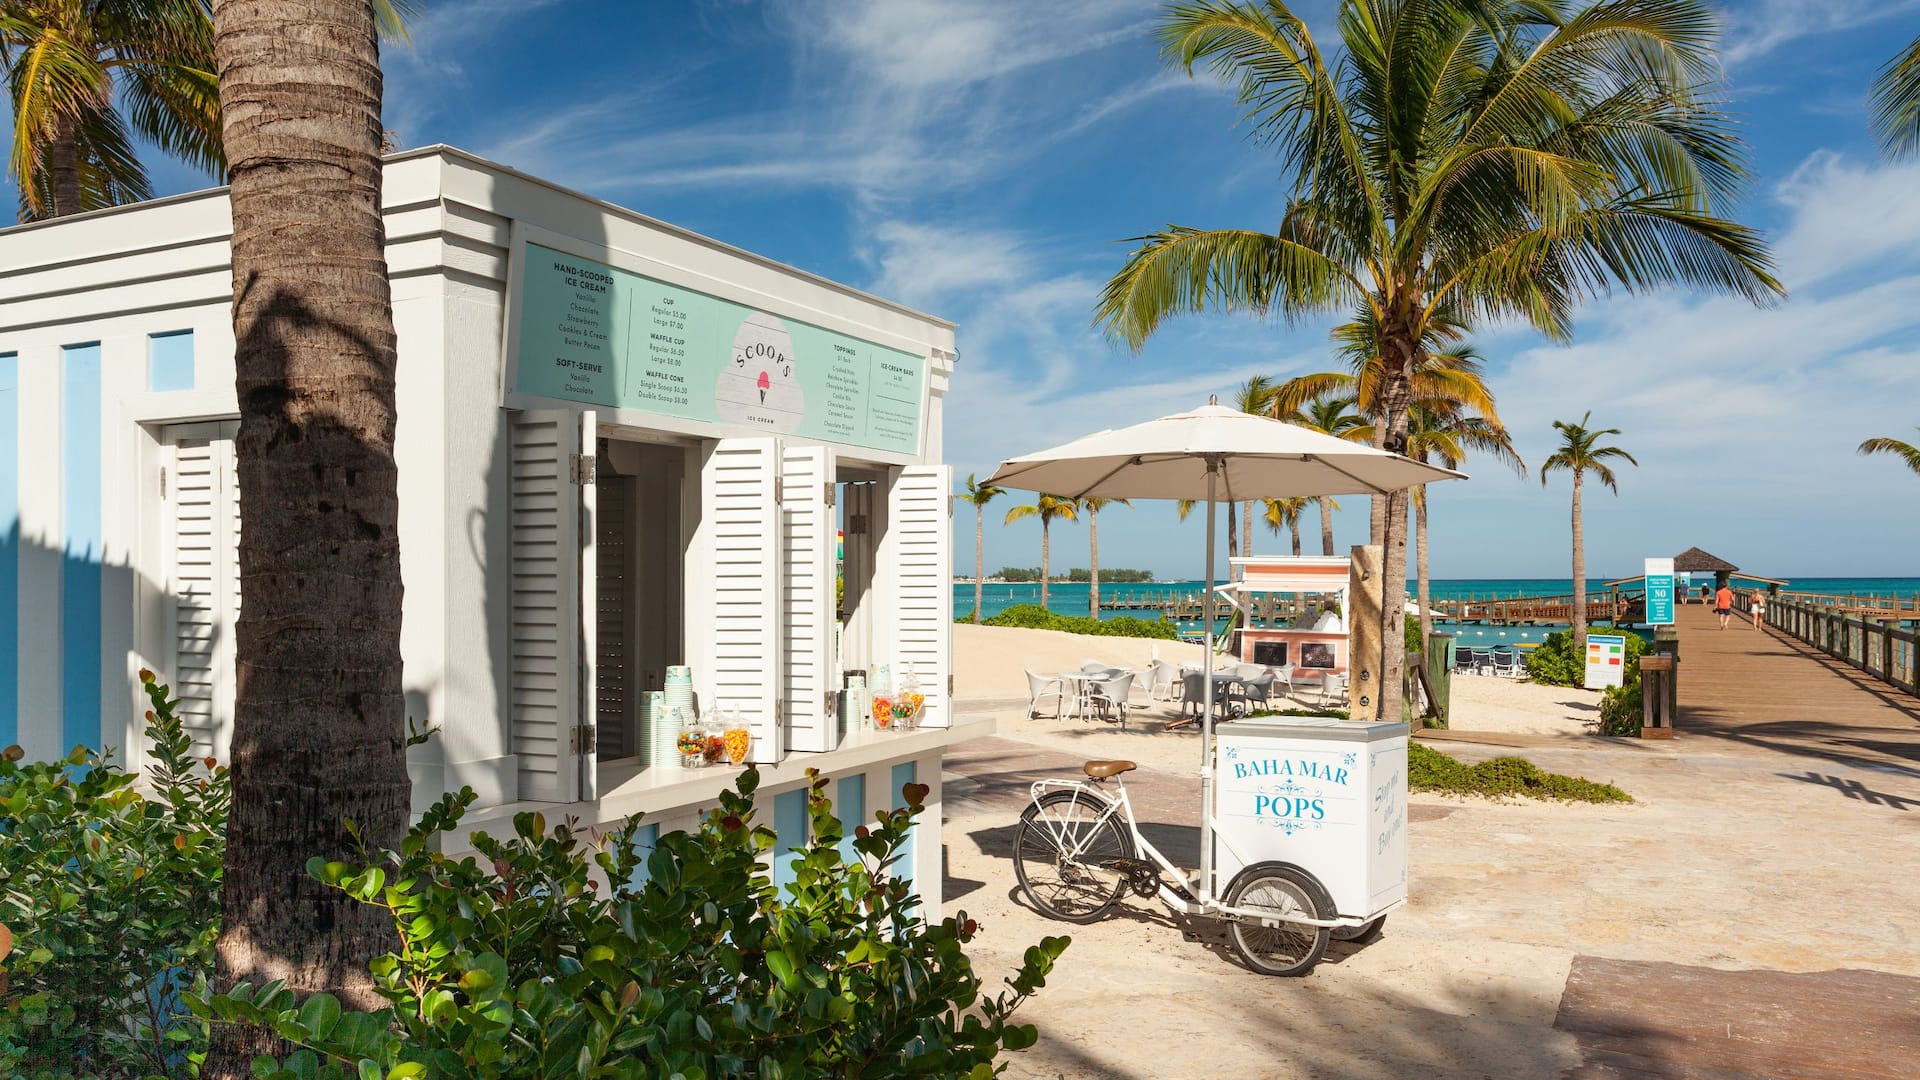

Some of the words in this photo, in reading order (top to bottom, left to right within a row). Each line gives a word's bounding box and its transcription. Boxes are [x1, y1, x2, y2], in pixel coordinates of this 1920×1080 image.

[554, 262, 615, 285] HAND-SCOOPED
[565, 276, 578, 287] ICE
[580, 281, 606, 294] CREAM
[576, 292, 596, 303] Vanilla
[663, 297, 675, 306] CUP
[570, 302, 599, 316] Chocolate
[652, 304, 672, 316] Regular
[567, 313, 599, 329] Strawberry
[653, 316, 668, 328] Large
[558, 324, 582, 336] Cookies
[589, 331, 608, 341] Cream
[650, 333, 673, 344] WAFFLE
[564, 337, 582, 348] Butter
[584, 341, 600, 351] Pecan
[650, 343, 669, 353] Regular
[834, 344, 856, 356] TOPPINGS
[556, 358, 602, 374] SOFT-SERVE
[651, 355, 666, 364] Large
[736, 342, 791, 378] SCOOPS
[646, 370, 668, 380] WAFFLE
[669, 374, 684, 383] CONE
[880, 362, 902, 374] ICE-CREAM
[903, 368, 914, 377] BARS
[570, 373, 590, 383] Vanilla
[564, 384, 594, 396] Chocolate
[640, 379, 657, 390] Single
[658, 382, 673, 393] Scoop
[638, 390, 657, 400] Double
[658, 394, 674, 404] Scoop
[1654, 589, 1666, 598] NO
[1234, 759, 1294, 779] BAHA
[1299, 760, 1349, 786] MAR
[1254, 794, 1325, 820] POPS
